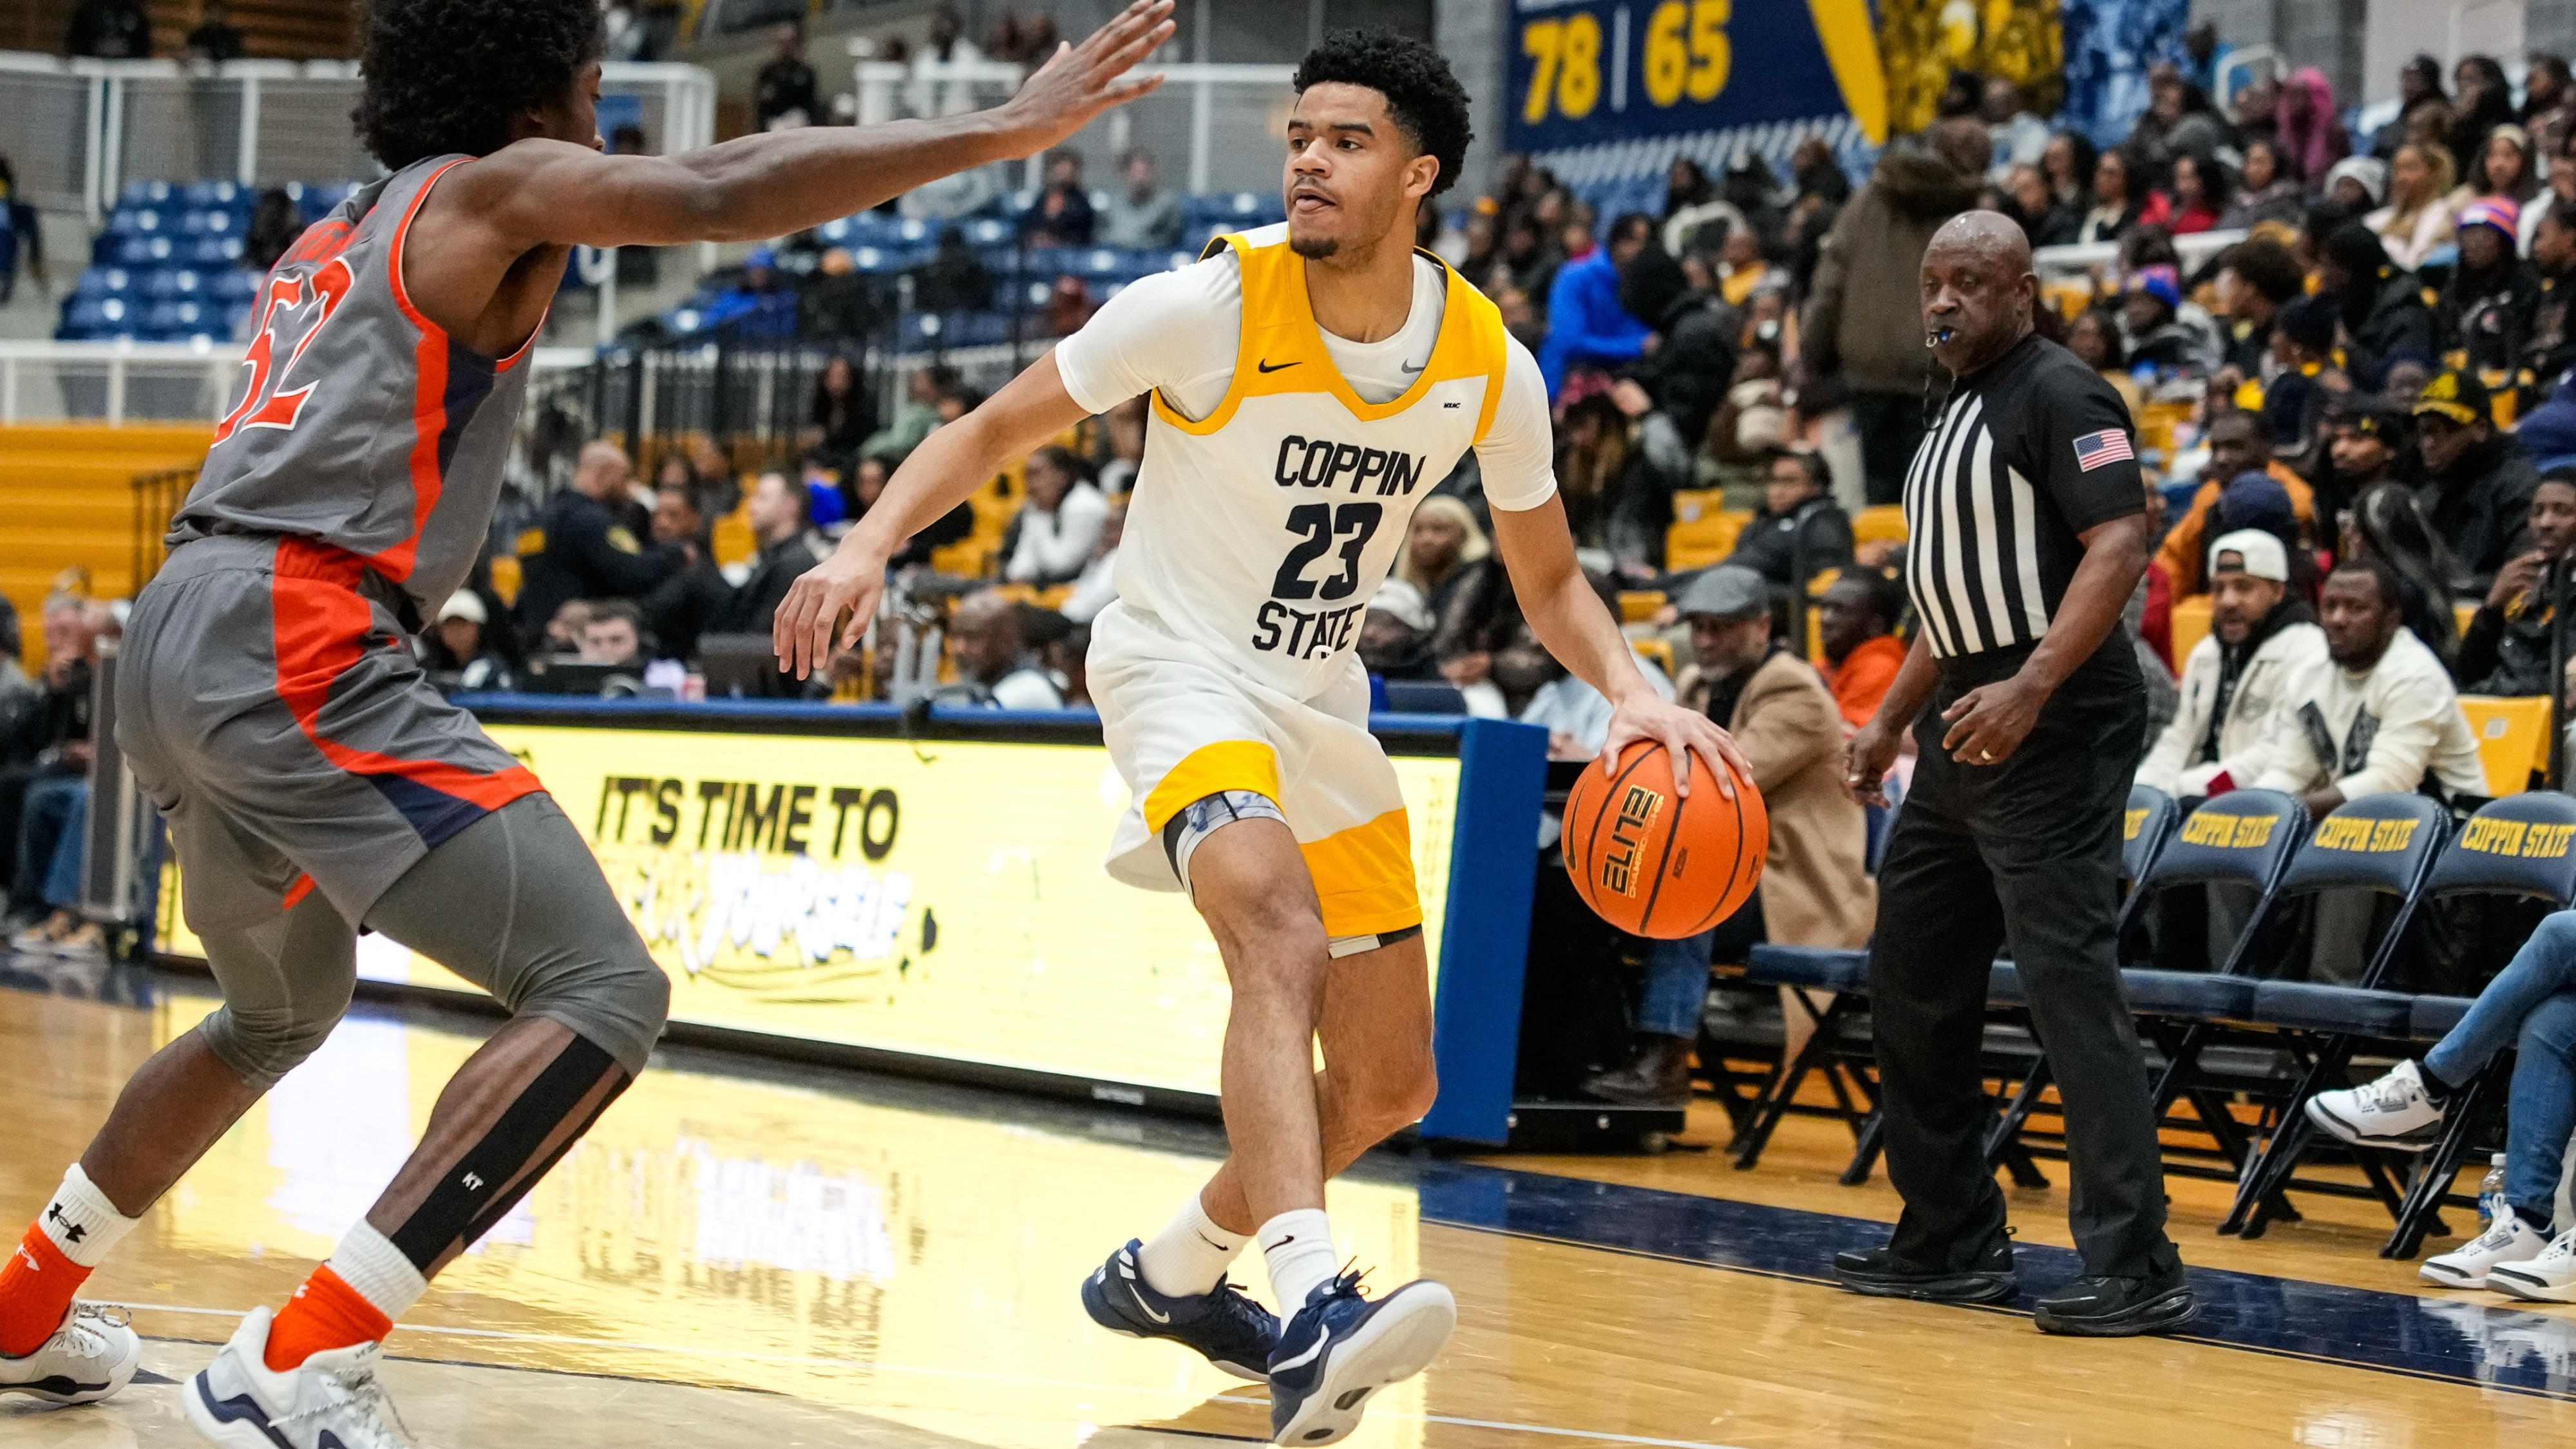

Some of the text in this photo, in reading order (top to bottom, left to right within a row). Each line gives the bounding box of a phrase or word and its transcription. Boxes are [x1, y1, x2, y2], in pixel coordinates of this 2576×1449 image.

[1522, 0, 1732, 125] 78 65
[1274, 435, 1426, 496] COPPIN
[1271, 502, 1382, 600] 23
[1252, 600, 1365, 660] STATE
[596, 776, 900, 862] IT'S TIME TO
[1601, 784, 1658, 896] ELITE
[2182, 811, 2240, 848] COPPIN
[2314, 815, 2420, 852] COPPIN STATE
[2460, 817, 2576, 858] COPPIN STATE
